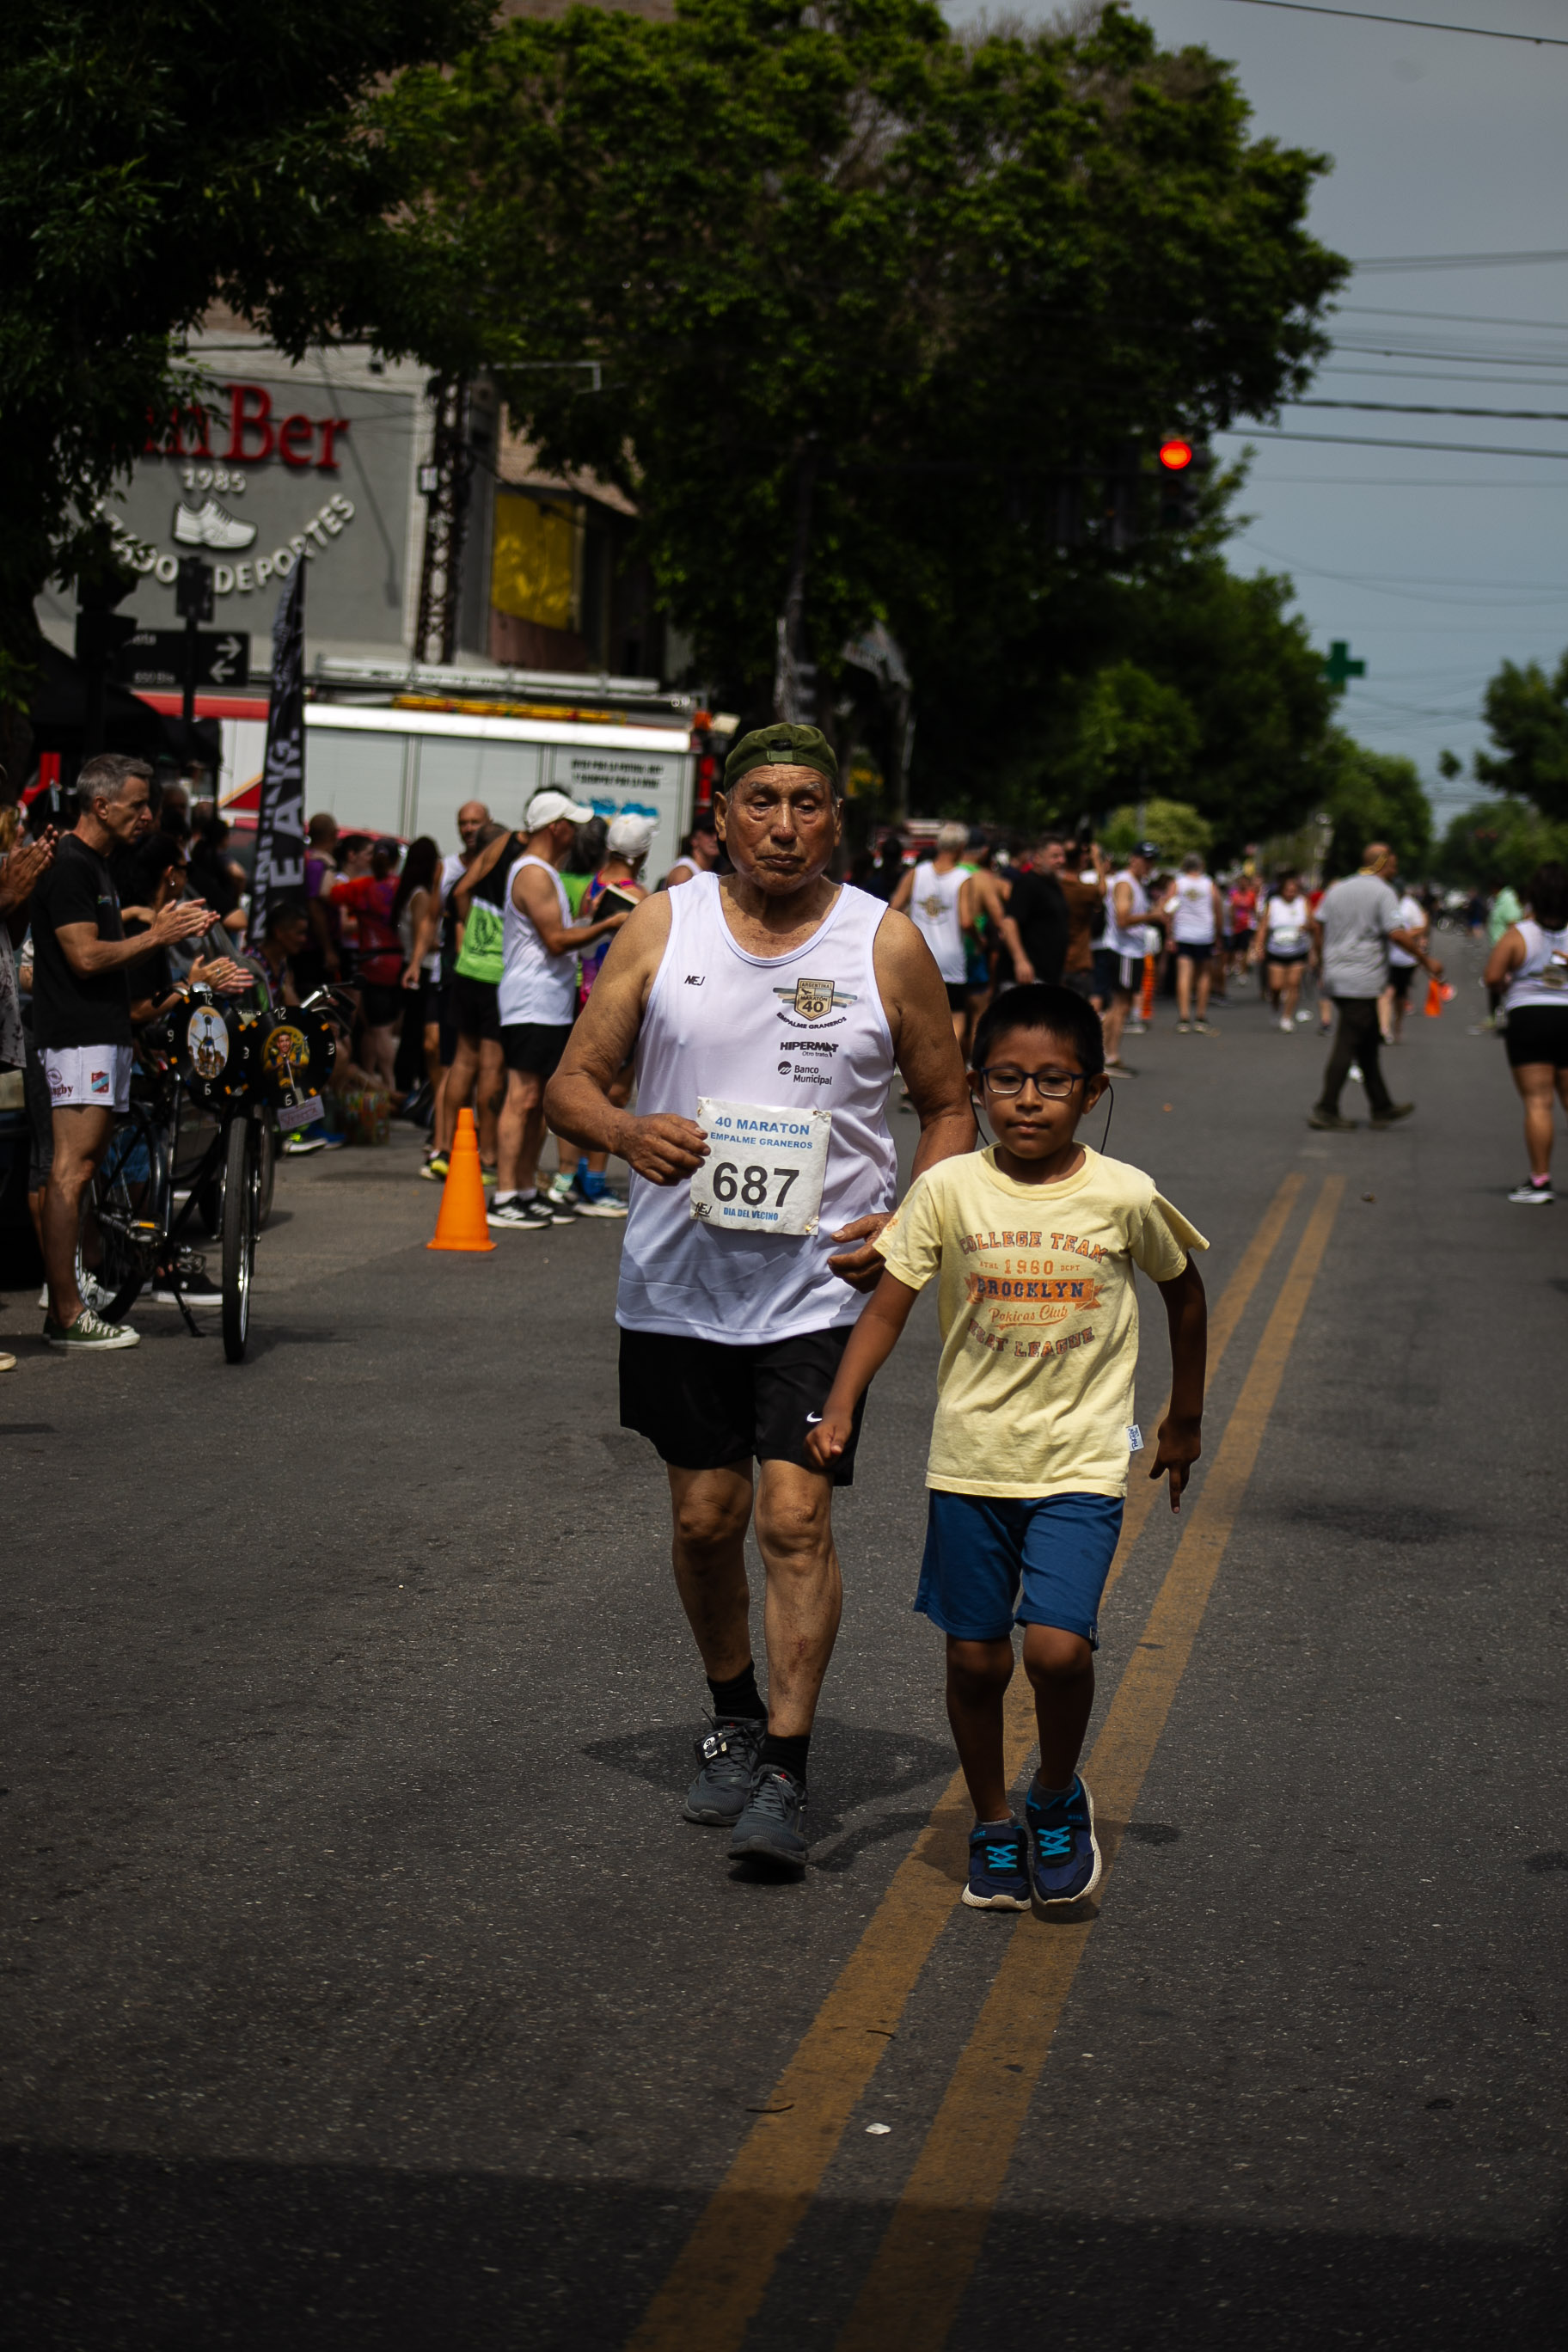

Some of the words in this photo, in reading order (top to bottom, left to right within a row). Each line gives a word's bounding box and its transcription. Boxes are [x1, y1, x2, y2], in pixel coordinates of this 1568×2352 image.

[182, 468, 247, 493] 1985
[684, 975, 706, 986] NEJ
[202, 993, 213, 1006] 12
[802, 1001, 824, 1013] 40
[274, 1008, 286, 1020] 12
[776, 1012, 807, 1029] EMPALME
[808, 1016, 847, 1029] GRANEROS
[794, 1065, 819, 1074] Banco
[793, 1075, 832, 1086] Municipal
[715, 1117, 732, 1128] 40
[737, 1119, 810, 1135] MARATON
[710, 1132, 756, 1145] EMPALME
[759, 1138, 813, 1149] GRANEROS
[713, 1162, 799, 1208] 687
[724, 1207, 736, 1216] DIA
[737, 1209, 750, 1218] DEL
[751, 1210, 778, 1221] VECINO
[959, 1231, 1042, 1255] COLLEGE
[1050, 1232, 1108, 1264] TEAM
[1004, 1259, 1054, 1275] 1960
[977, 1277, 1085, 1298] BROOKLYN
[1039, 1304, 1069, 1320] Club
[1014, 1326, 1095, 1358] LEAGUE
